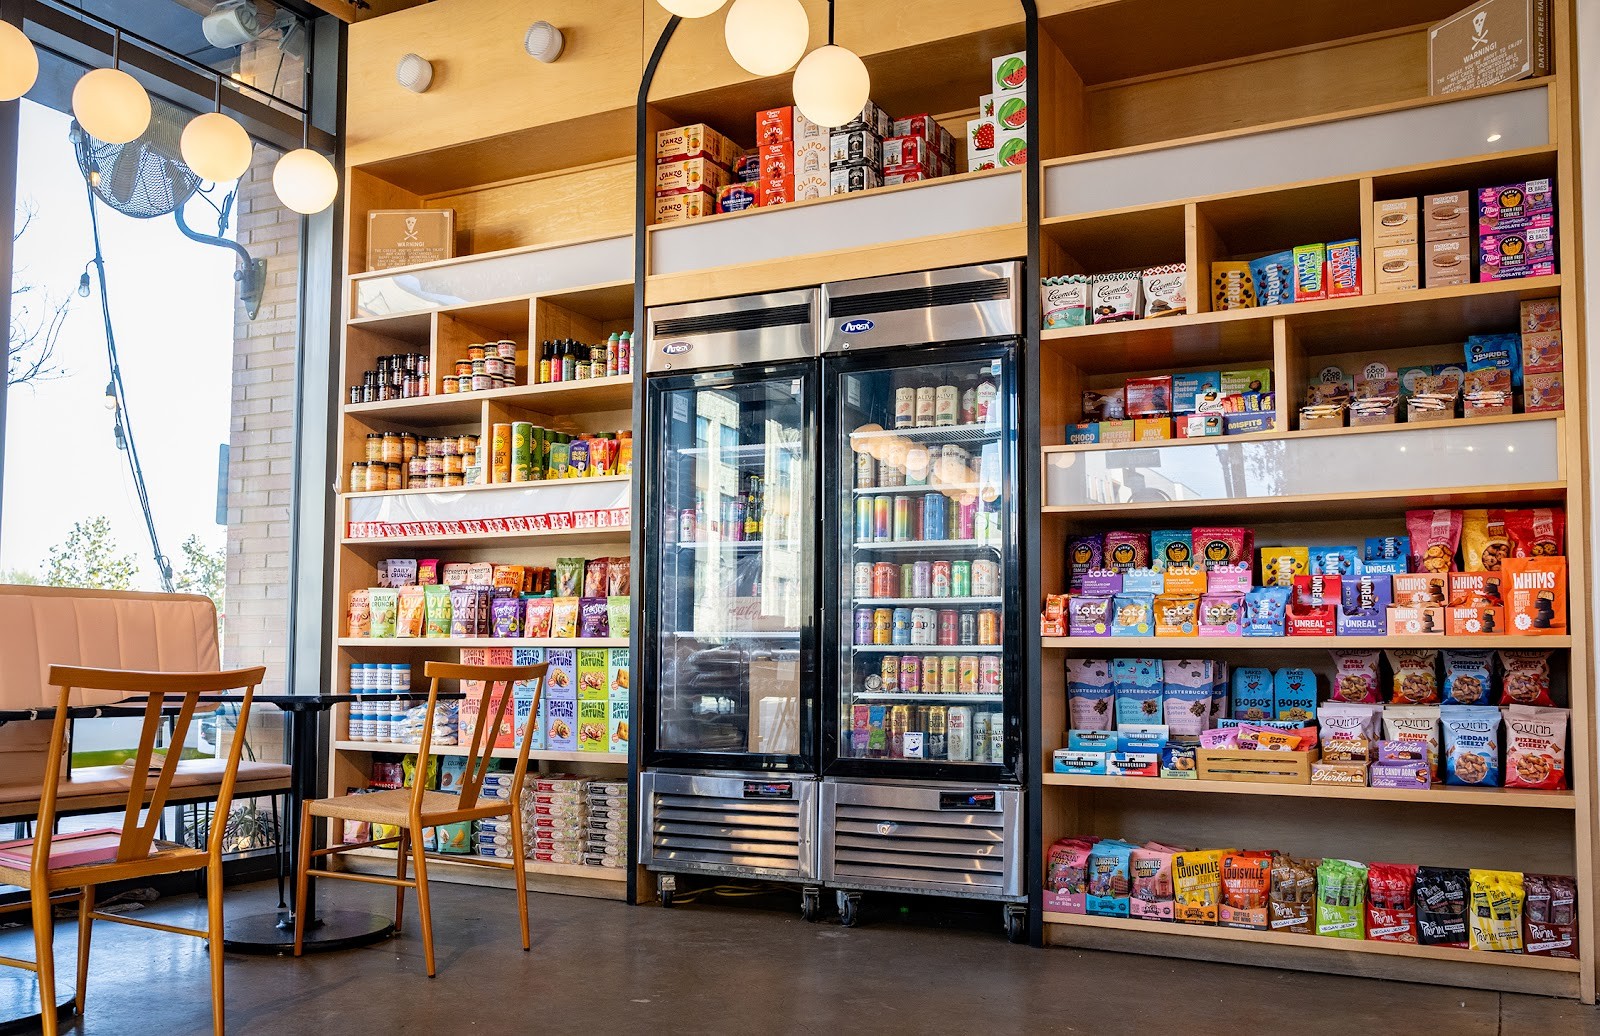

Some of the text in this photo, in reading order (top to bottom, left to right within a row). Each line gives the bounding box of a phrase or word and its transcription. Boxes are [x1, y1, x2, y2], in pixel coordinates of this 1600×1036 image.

[1508, 38, 1523, 50] ENJOY
[1463, 41, 1497, 64] WARNING!
[764, 126, 784, 138] OLIPOP
[660, 136, 682, 148] SANZO
[796, 142, 826, 157] OLIPOP
[766, 162, 786, 172] OLIPOP
[660, 170, 682, 180] SANZO
[798, 176, 826, 192] OLIPOP
[658, 203, 682, 214] SANZO
[1265, 263, 1280, 306] UNREA
[1228, 270, 1242, 310] UNREA
[845, 322, 869, 332] Atosa
[667, 342, 689, 353] Atosa
[1472, 350, 1508, 362] JOYRIDE
[1228, 419, 1262, 429] MISFITS
[1102, 430, 1132, 440] PERFECT
[1143, 428, 1162, 437] HOLY
[1070, 434, 1095, 442] CHOCO
[1088, 568, 1114, 578] toto
[1128, 568, 1156, 577] toto
[1168, 566, 1197, 576] toto
[1214, 564, 1242, 574] toto
[1366, 565, 1396, 574] UNREAL
[1396, 578, 1426, 590] WHIMS
[1452, 577, 1484, 589] WHIMS
[1513, 572, 1554, 589] WHIMS
[1312, 576, 1324, 607] UNREAL
[1361, 576, 1372, 610] UNREAL
[1075, 604, 1105, 615] toto
[1118, 606, 1146, 616] toto
[1162, 606, 1192, 616] toto
[1395, 609, 1418, 618] WHIMS
[1454, 608, 1478, 618] WHIMS
[1294, 620, 1324, 628] UNREAL
[1346, 620, 1376, 628] UNREAL
[516, 650, 540, 658] BACK TO
[549, 650, 572, 658] BACK TO
[580, 650, 604, 658] BACK TO
[464, 658, 484, 666] NATURE
[490, 658, 512, 666] NATURE
[549, 658, 572, 666] NATURE
[580, 658, 604, 666] NATURE
[1235, 698, 1272, 707] BOBO'S
[1278, 698, 1312, 708] BOBO'S
[550, 708, 573, 717] NATURE
[581, 710, 605, 718] NATURE
[1212, 738, 1226, 746] OUT
[1515, 736, 1550, 744] PIZZERIA
[1324, 740, 1366, 754] Harken
[1384, 742, 1422, 754] Harken
[1518, 742, 1548, 750] CHEEZY
[1312, 770, 1352, 782] Harken
[1386, 768, 1401, 776] CANDY
[1402, 768, 1416, 776] AGAIN
[1096, 858, 1118, 866] LOUISVILLE
[1135, 860, 1161, 870] LOUISVILLE
[1178, 861, 1220, 878] LOUISVILLE
[1224, 868, 1264, 879] LOUISVILLE
[1179, 874, 1214, 886] VEGAN JERKY
[1225, 880, 1258, 888] VEGAN JERKY
[1272, 919, 1289, 928] VEGAN
[1321, 924, 1338, 932] VEGAN
[1372, 928, 1390, 936] VEGAN
